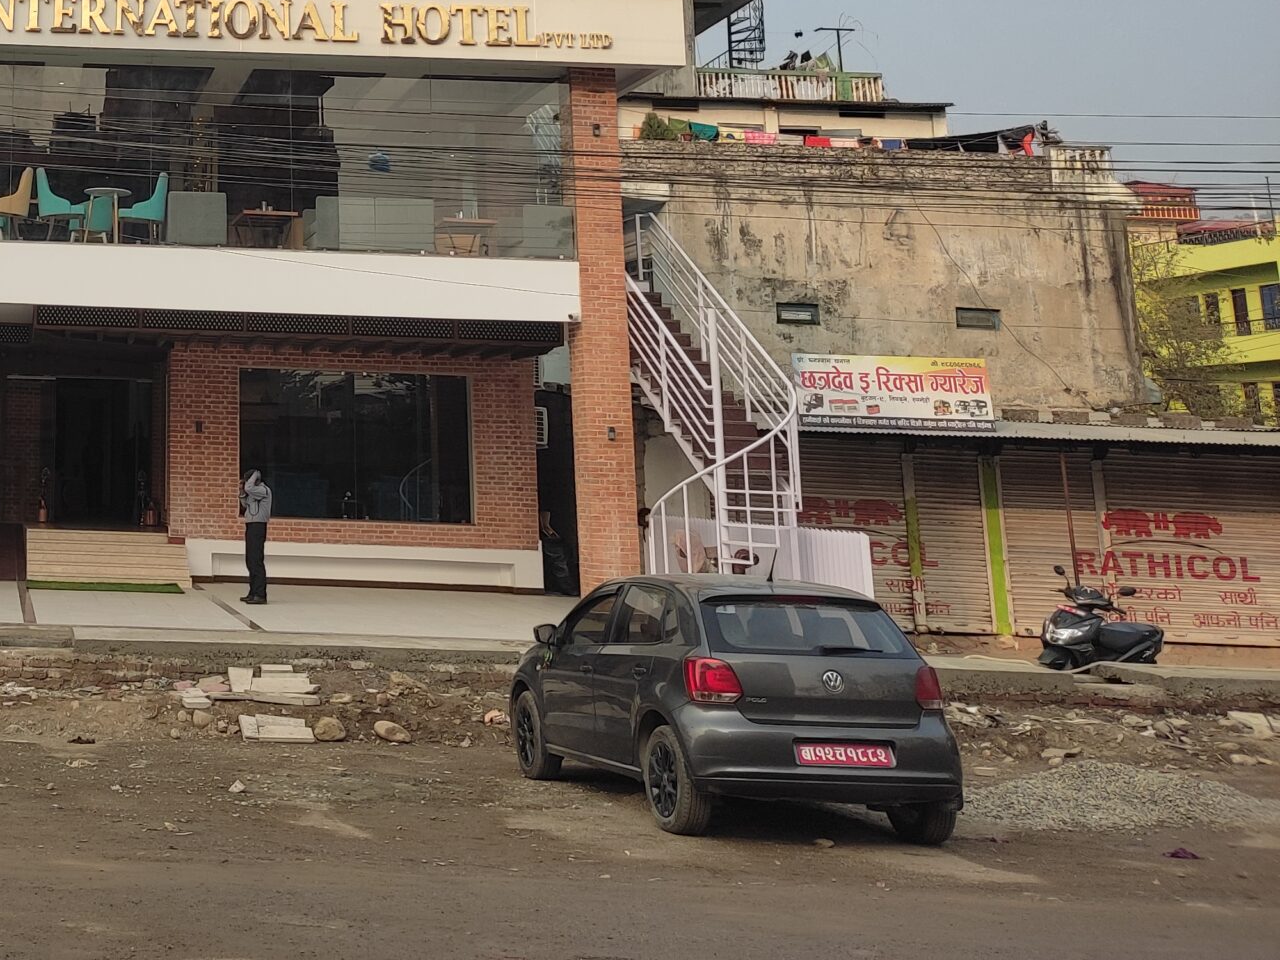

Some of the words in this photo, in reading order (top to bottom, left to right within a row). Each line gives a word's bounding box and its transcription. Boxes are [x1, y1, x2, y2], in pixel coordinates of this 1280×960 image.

[380, 3, 540, 47] HOTEL
[541, 32, 576, 48] PVT
[579, 32, 613, 49] LTD
[1075, 550, 1261, 582] RATHICOL
